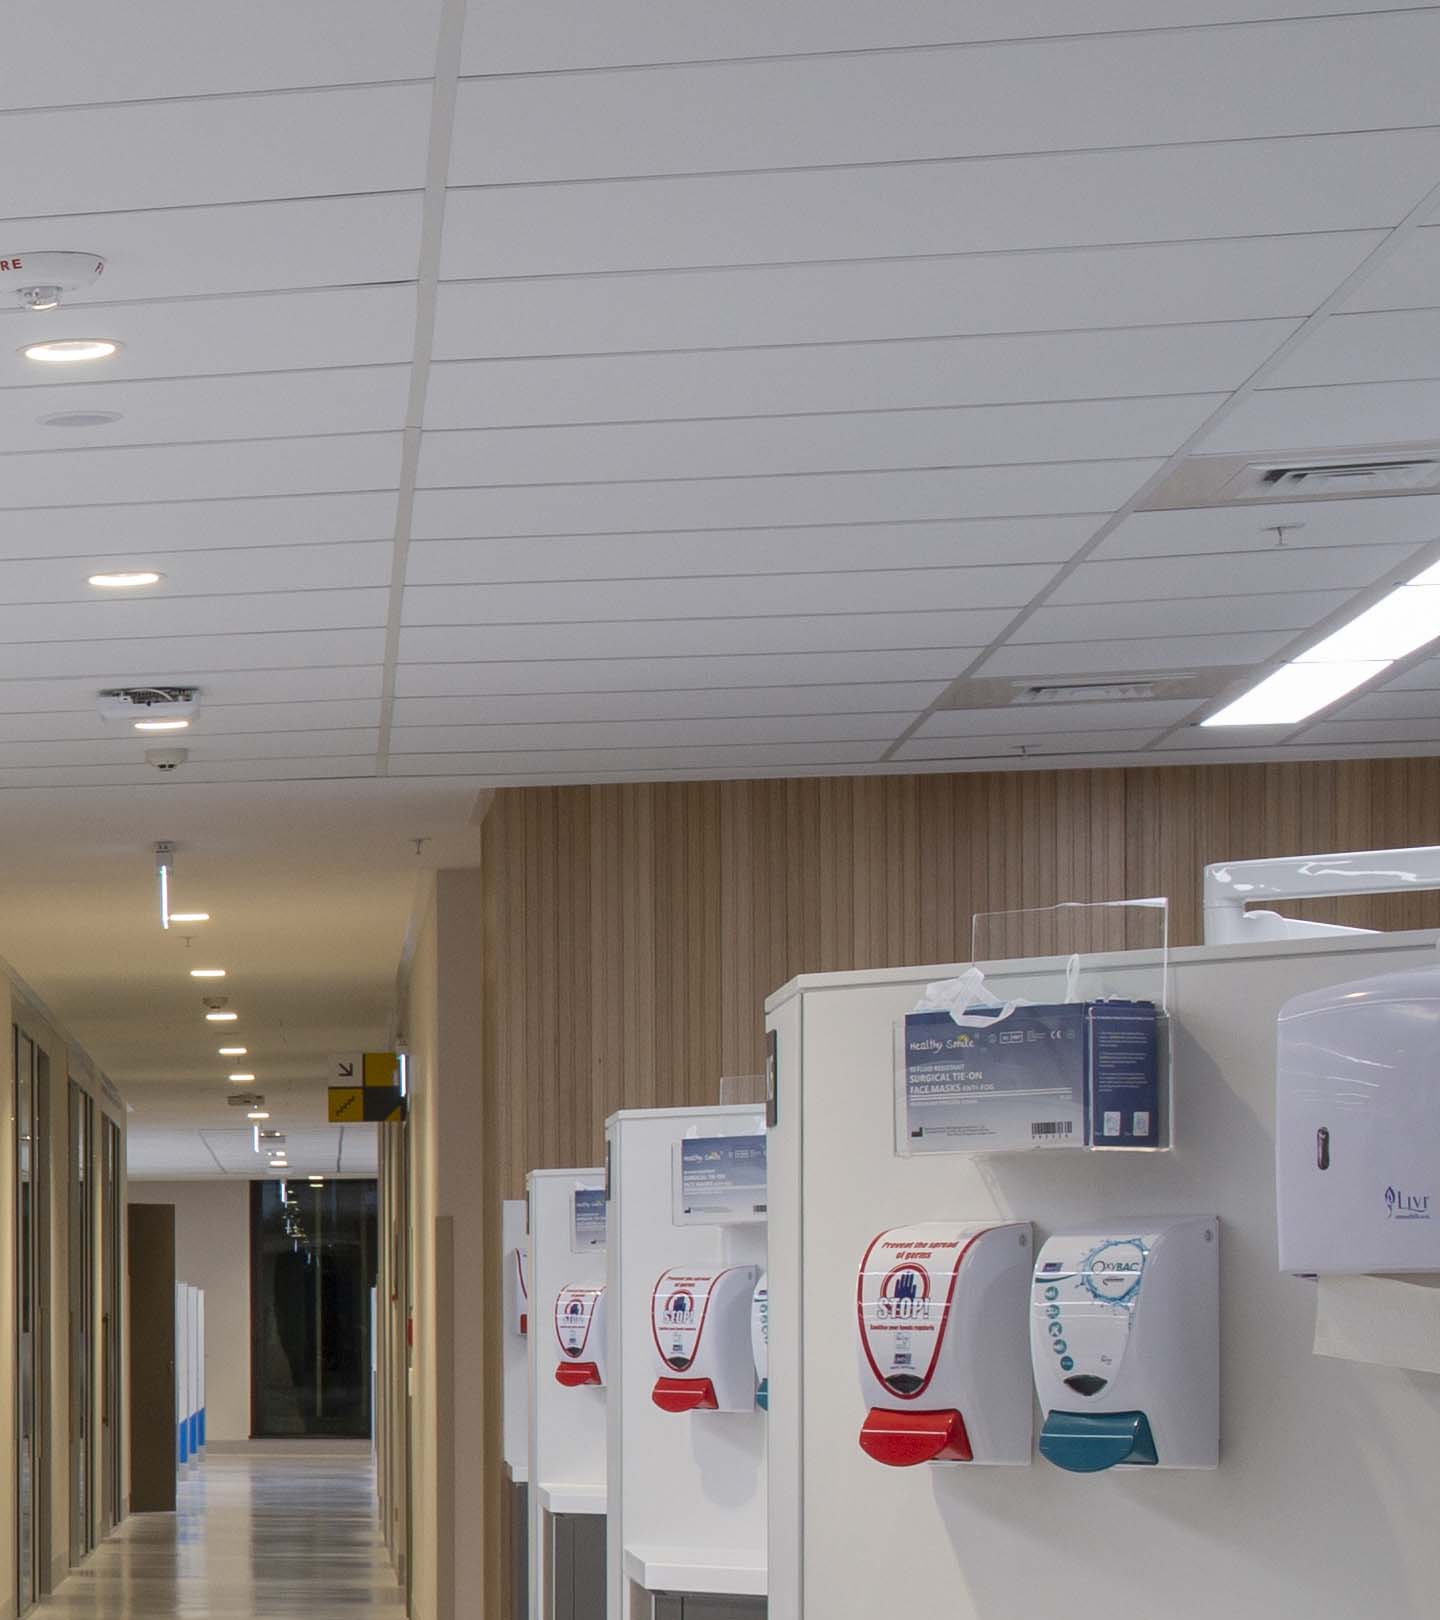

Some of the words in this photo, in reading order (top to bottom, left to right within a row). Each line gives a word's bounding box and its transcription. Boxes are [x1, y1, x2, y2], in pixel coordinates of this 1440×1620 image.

[910, 1038, 943, 1054] Healthy
[945, 1036, 976, 1049] Smile
[910, 1072, 951, 1084] SURGICAL
[952, 1070, 983, 1082] TIE-ON
[910, 1085, 930, 1095] FACE
[931, 1083, 961, 1094] MASKS
[881, 1241, 915, 1249] Prevent
[913, 1241, 929, 1249] the
[928, 1241, 959, 1250] spread
[877, 1297, 930, 1320] STOP!
